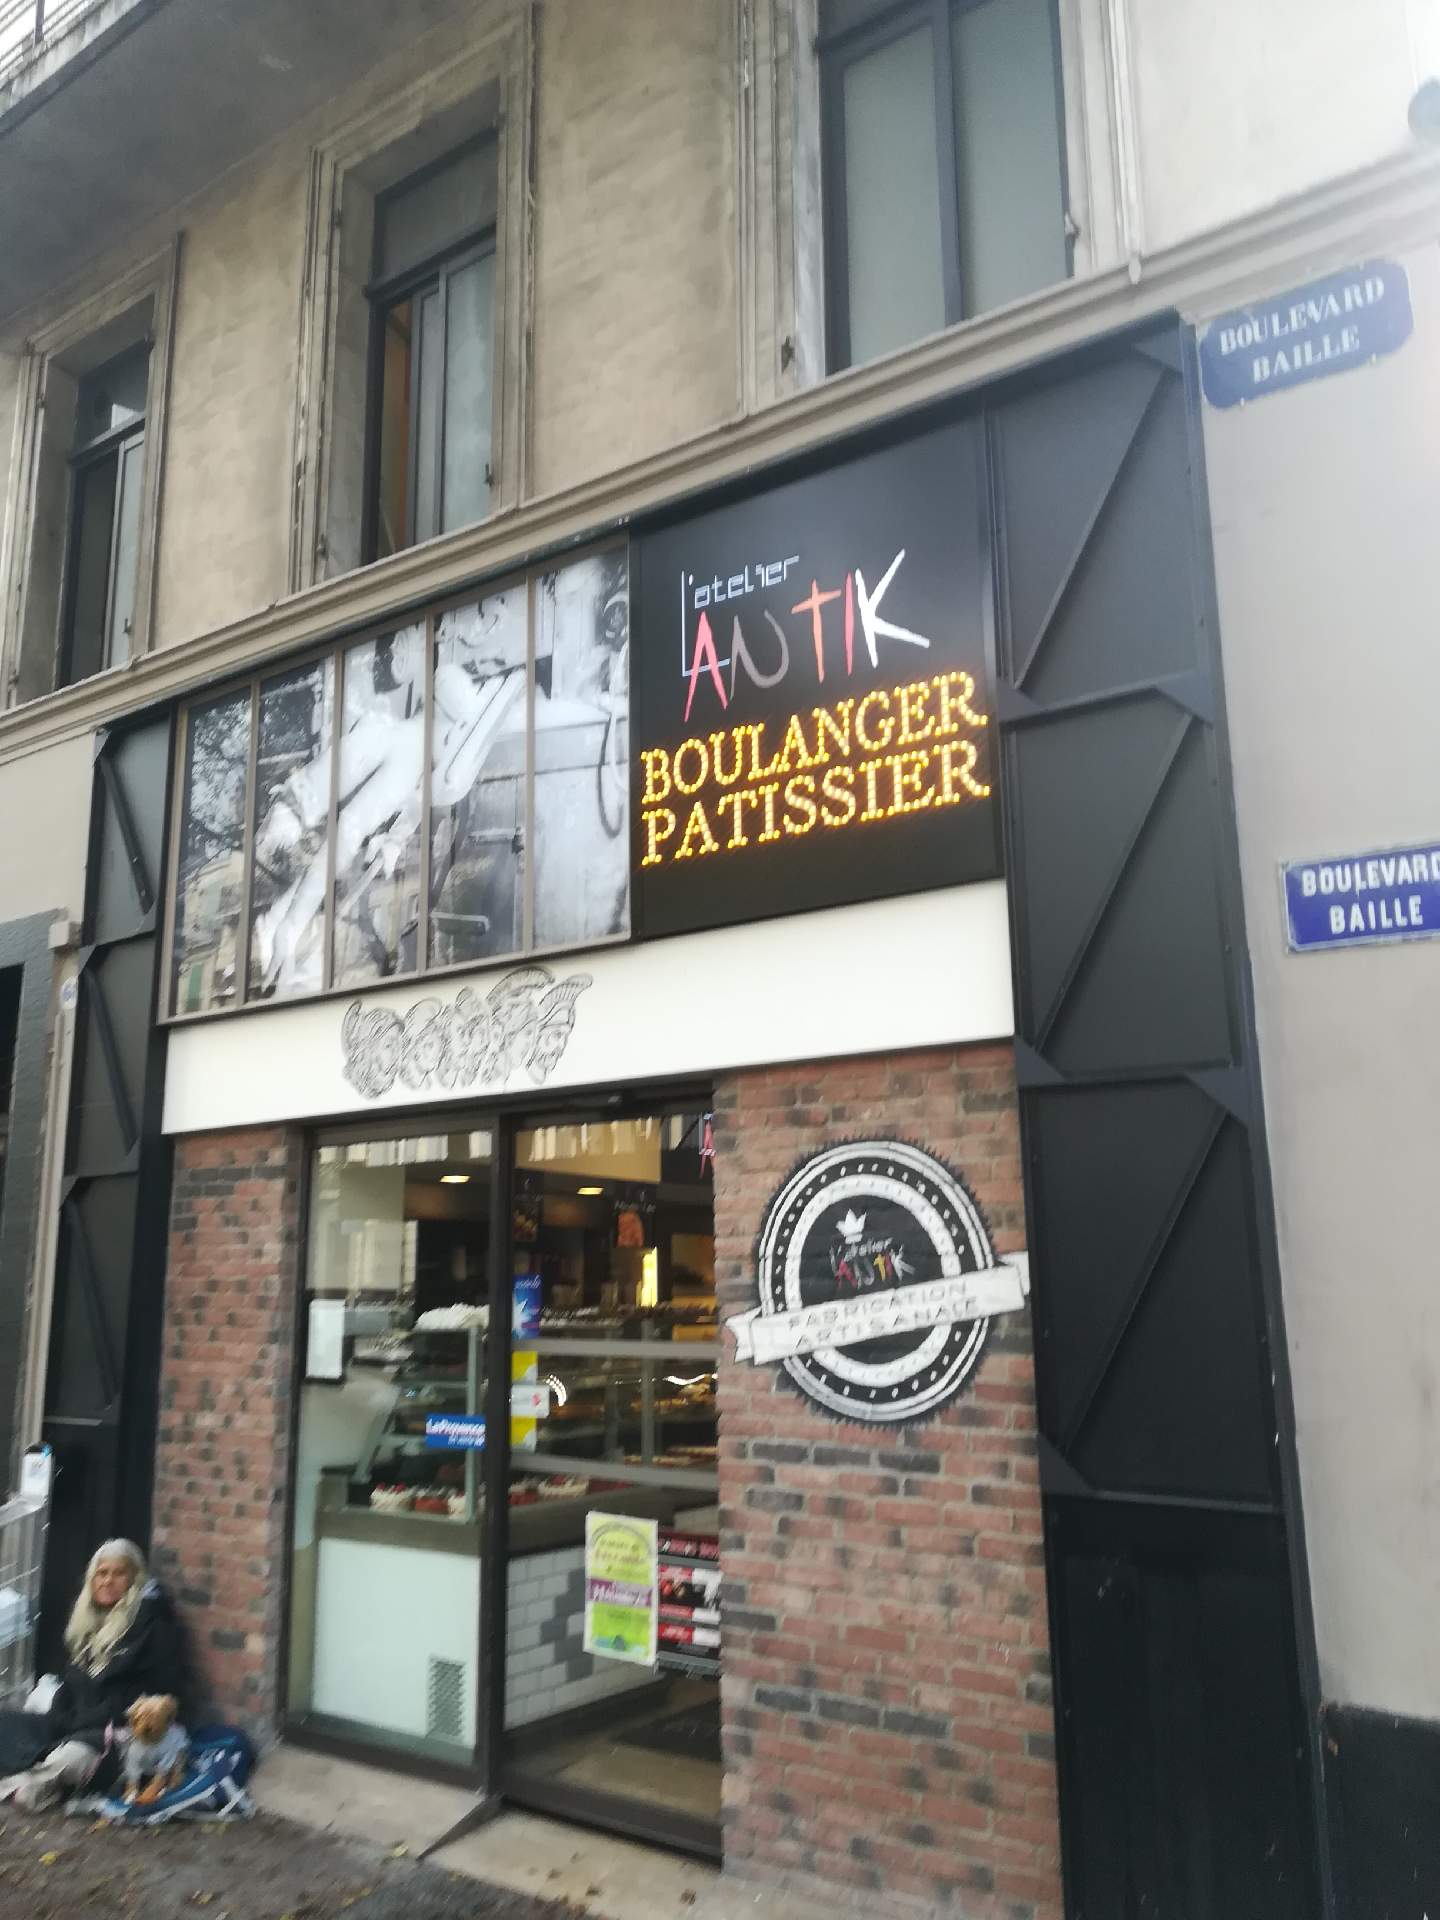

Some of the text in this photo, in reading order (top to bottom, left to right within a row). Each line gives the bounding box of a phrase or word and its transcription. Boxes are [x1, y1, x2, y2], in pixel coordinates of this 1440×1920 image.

[1220, 276, 1385, 356] BOULEVARD
[1252, 325, 1360, 384] BAILLE
[684, 548, 930, 723] ANTIK
[640, 671, 988, 804] BOULANGER
[640, 740, 990, 866] PATISSIER
[1329, 894, 1424, 934] BAILLE
